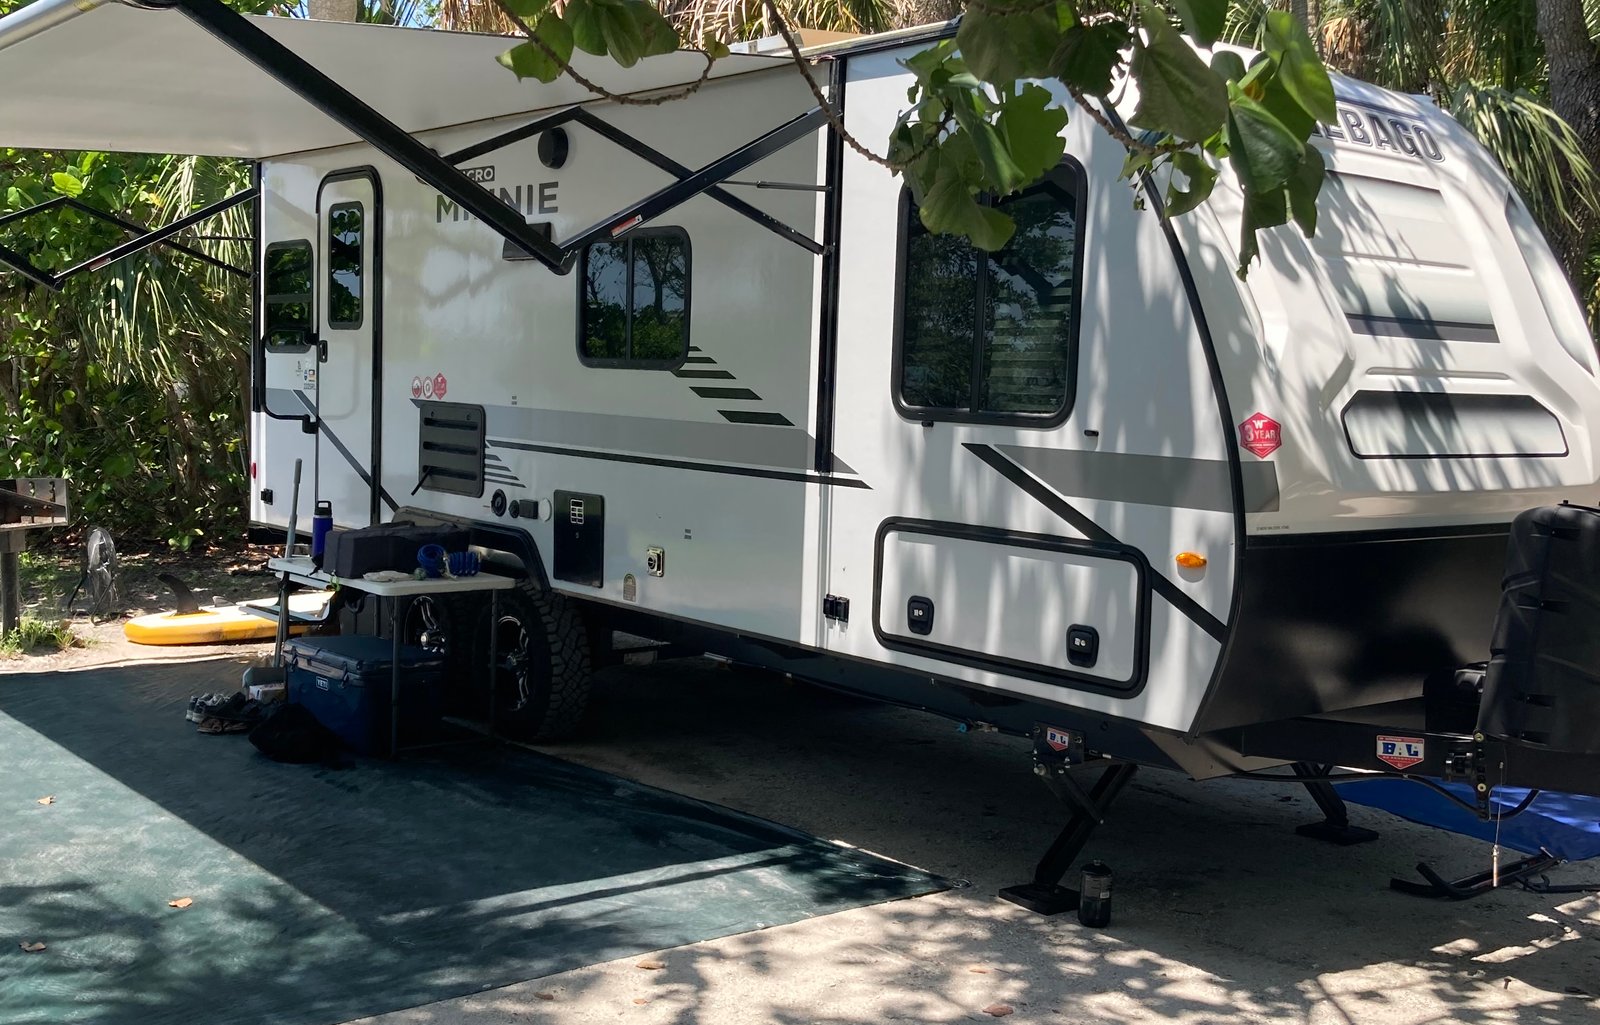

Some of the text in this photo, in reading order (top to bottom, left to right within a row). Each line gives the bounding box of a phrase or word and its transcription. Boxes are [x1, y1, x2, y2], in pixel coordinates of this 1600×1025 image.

[462, 167, 494, 181] CRO
[436, 181, 559, 223] MNIE
[1245, 424, 1276, 442] 3 YEAR
